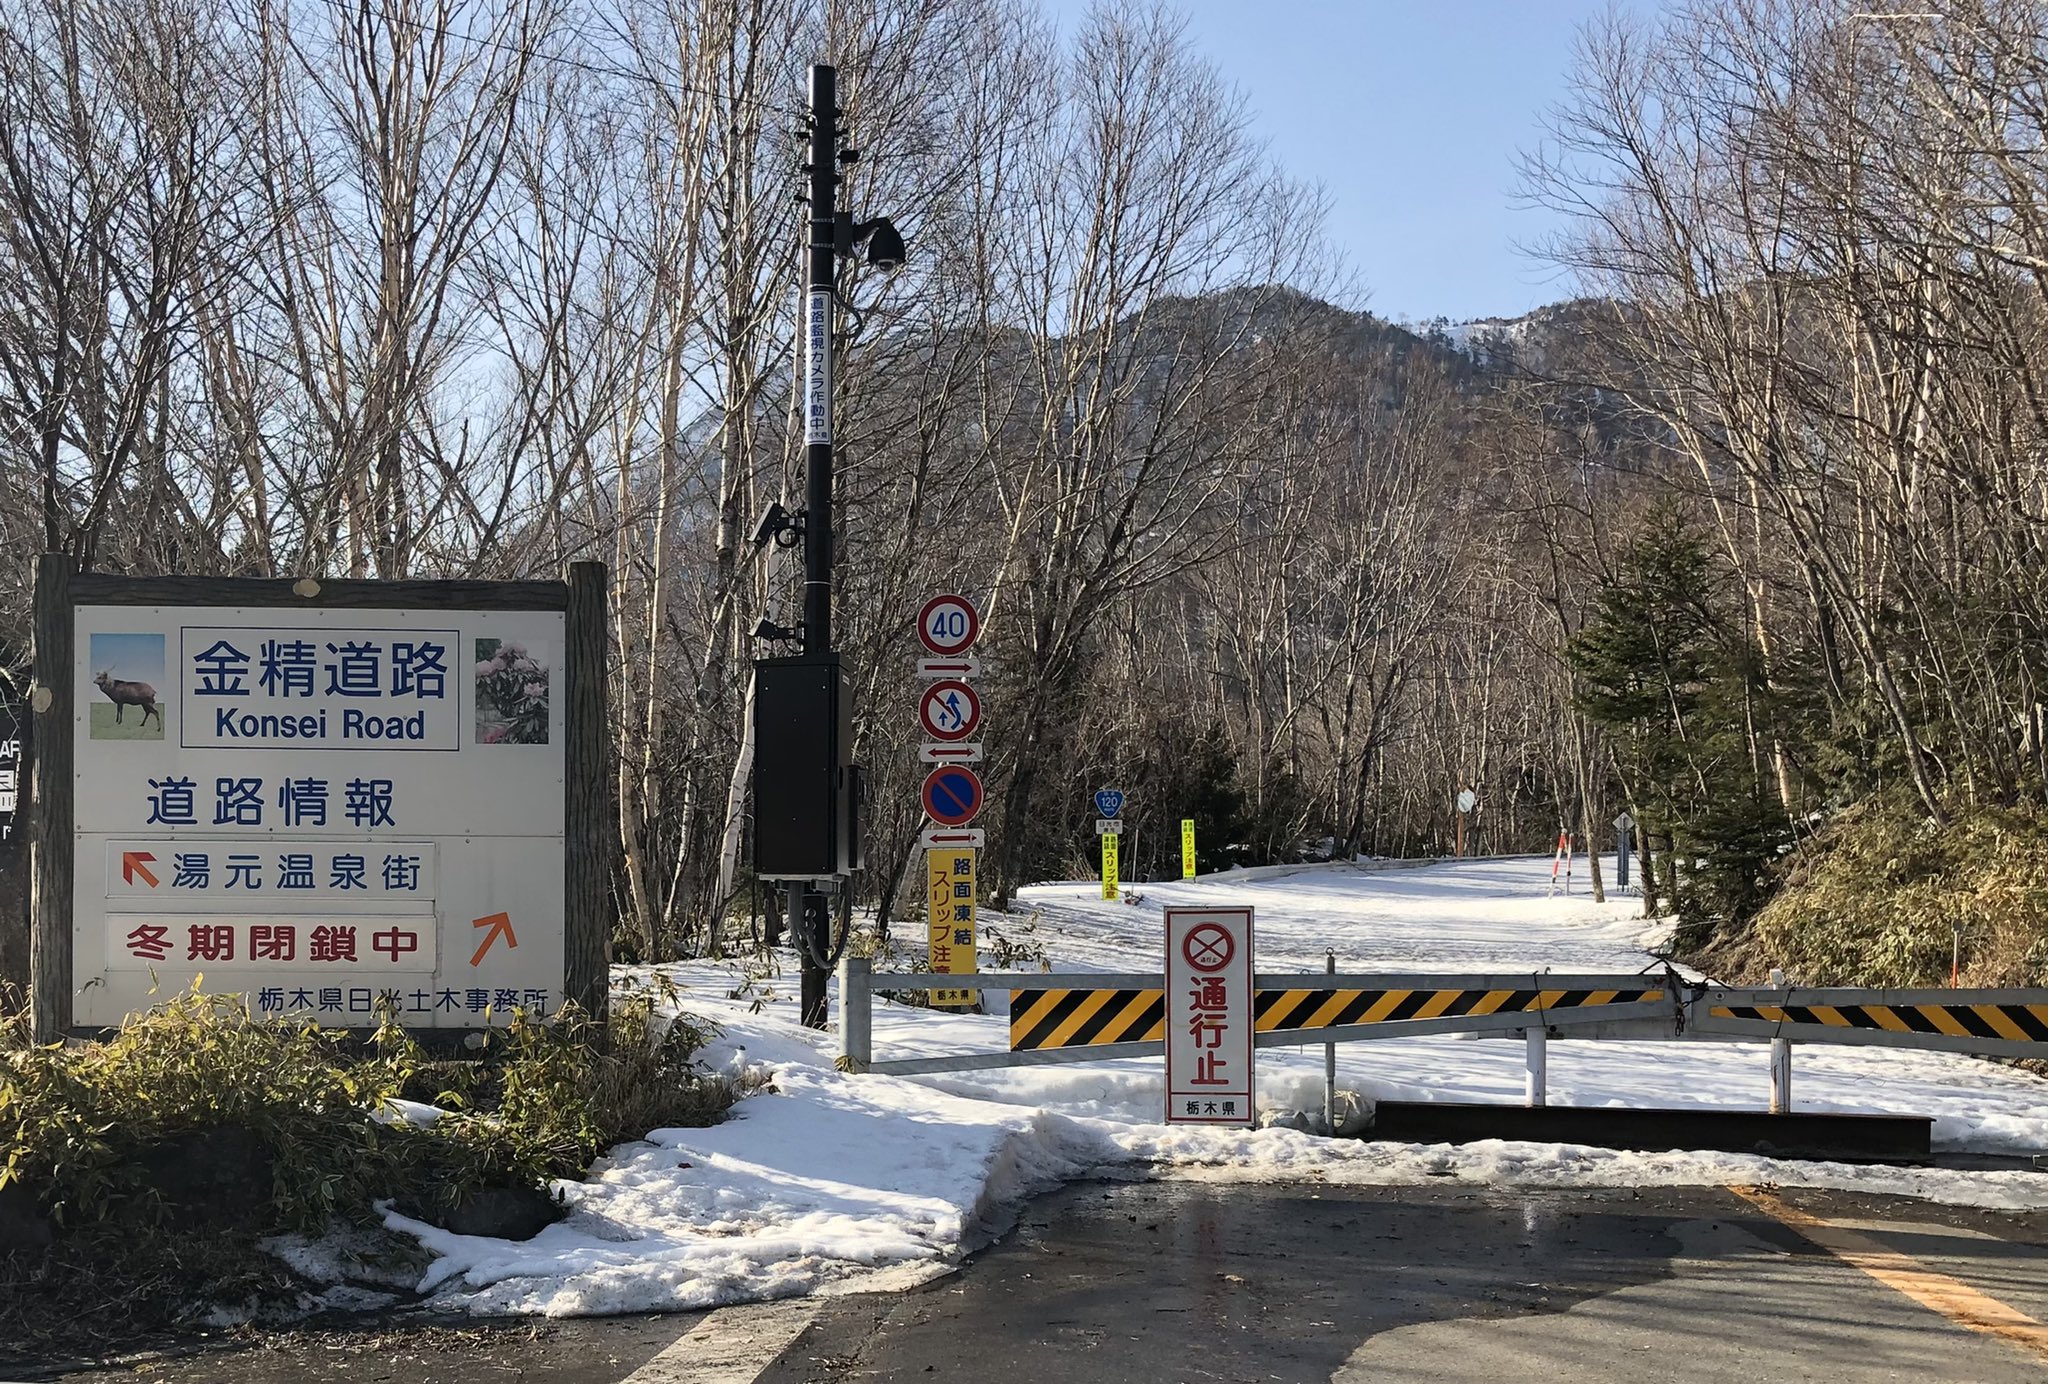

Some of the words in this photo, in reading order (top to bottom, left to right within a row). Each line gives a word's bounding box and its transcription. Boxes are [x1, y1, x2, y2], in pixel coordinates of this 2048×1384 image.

[810, 298, 825, 430] 道路監視カメラ作動中
[932, 612, 964, 638] 40
[193, 640, 448, 699] 金精道路
[216, 708, 326, 738] Konsei
[343, 709, 425, 739] Road
[146, 776, 396, 827] 道路情報
[1101, 797, 1118, 807] 120
[172, 853, 421, 890] 湯元温泉街
[953, 858, 972, 946] 路面凍結
[127, 924, 418, 963] 冬期閉鎖中
[937, 989, 969, 1001] 栃木県
[1189, 976, 1229, 1085] 通行止
[1186, 1101, 1235, 1116] 栃木県
